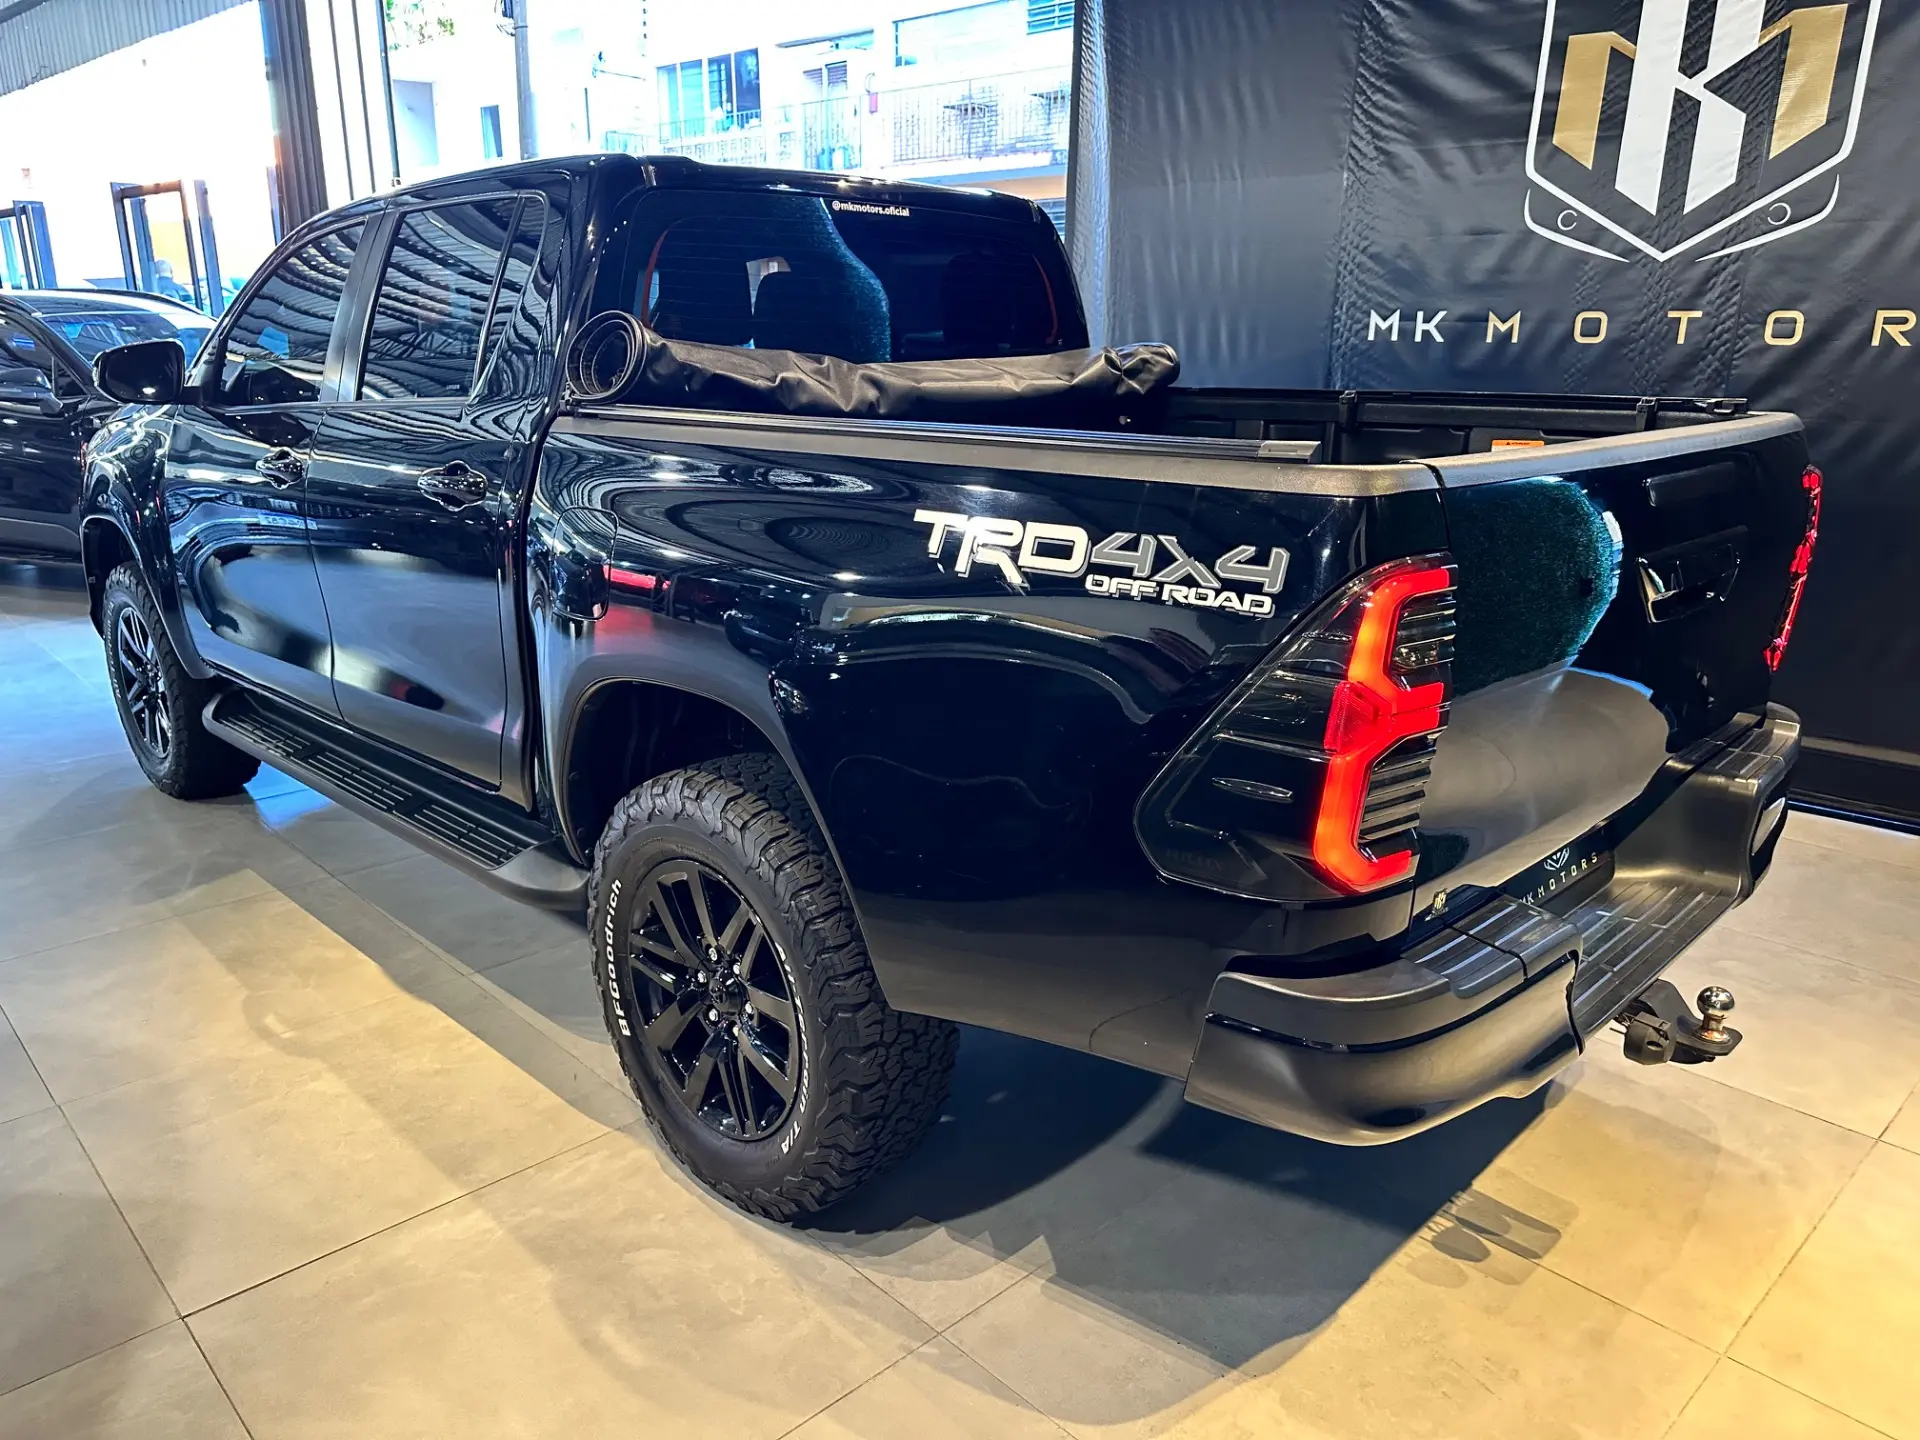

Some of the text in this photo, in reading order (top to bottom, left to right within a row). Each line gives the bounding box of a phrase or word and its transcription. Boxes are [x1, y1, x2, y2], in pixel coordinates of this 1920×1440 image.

[832, 200, 910, 217] @mkmotors.oficial
[914, 509, 1092, 596] TRD
[1085, 573, 1276, 618] OFF ROAD
[604, 879, 631, 1037] BFGoodrich
